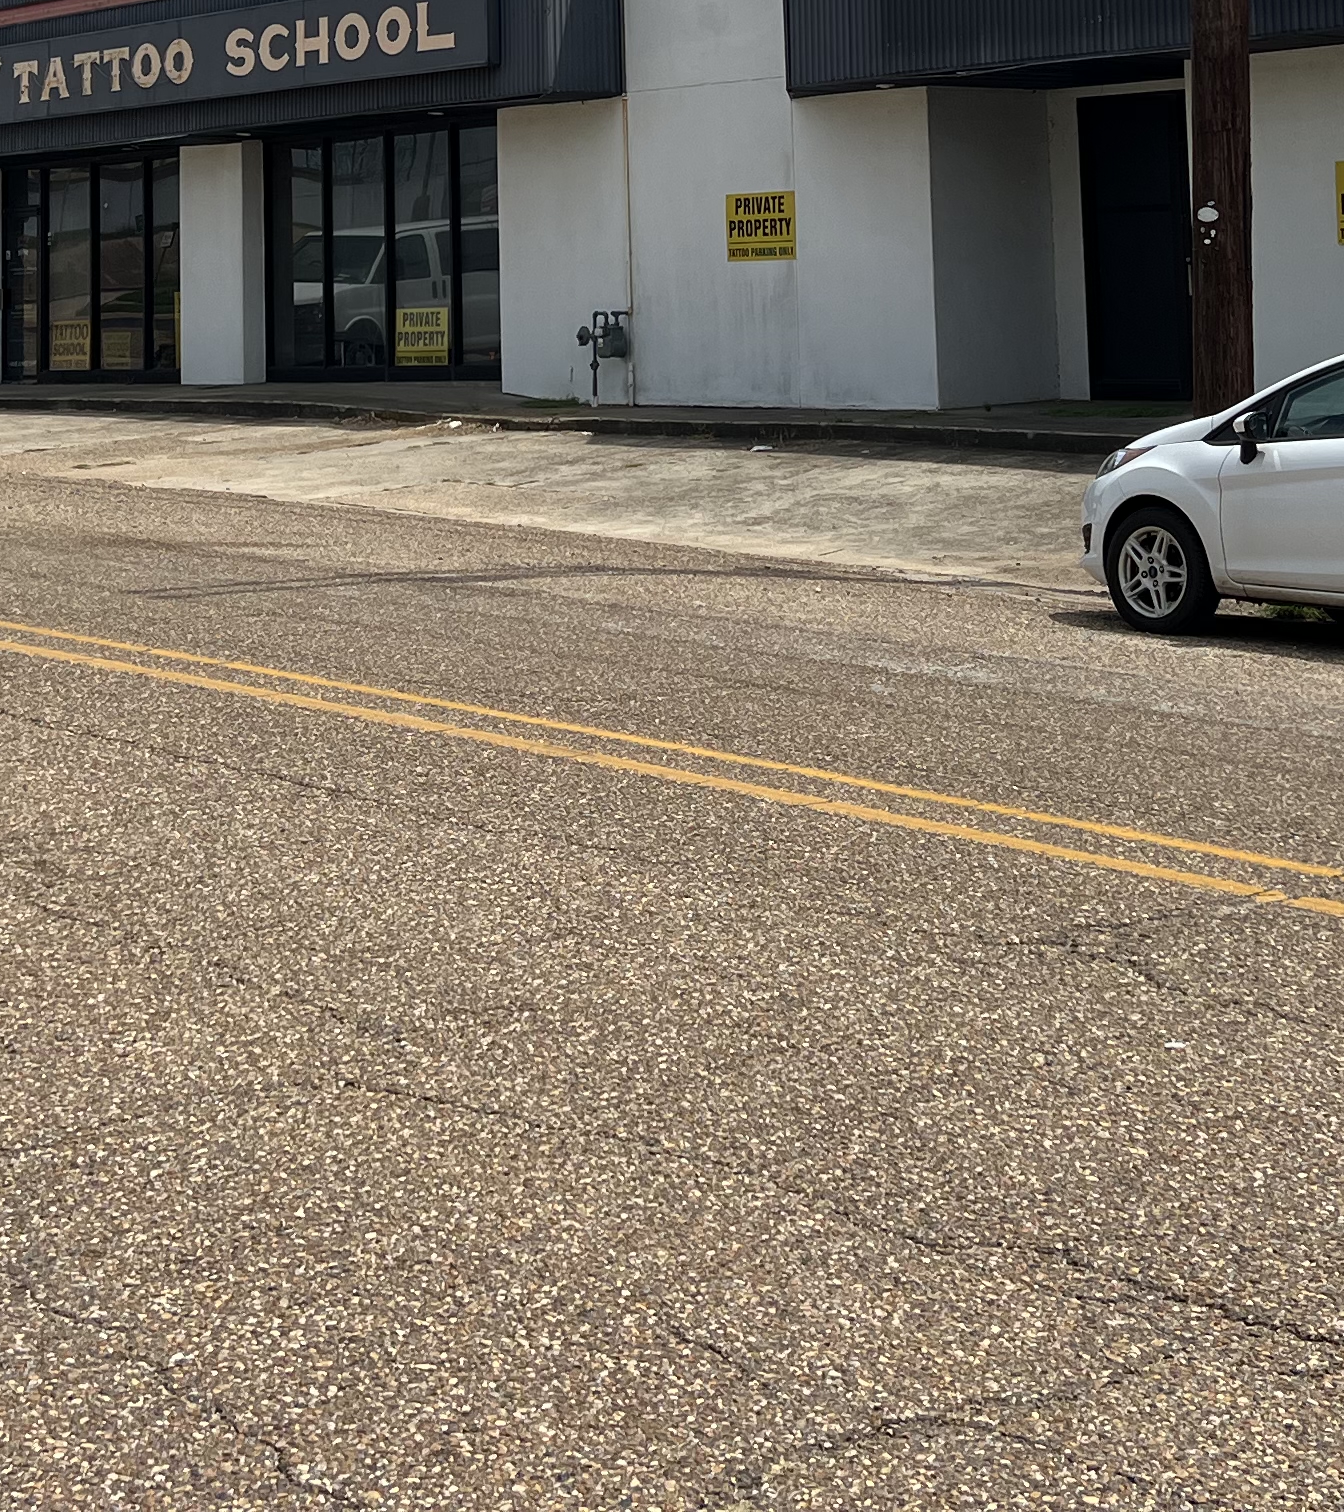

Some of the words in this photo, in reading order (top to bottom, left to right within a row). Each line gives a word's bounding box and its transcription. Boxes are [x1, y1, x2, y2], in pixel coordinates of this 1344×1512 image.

[13, 38, 194, 104] TATTOO
[225, 1, 456, 77] SCHOOL
[735, 195, 785, 216] PRIVATE
[729, 217, 792, 238] PROPERTY
[402, 311, 441, 328] PRIVATE
[397, 331, 446, 347] PROPERTY
